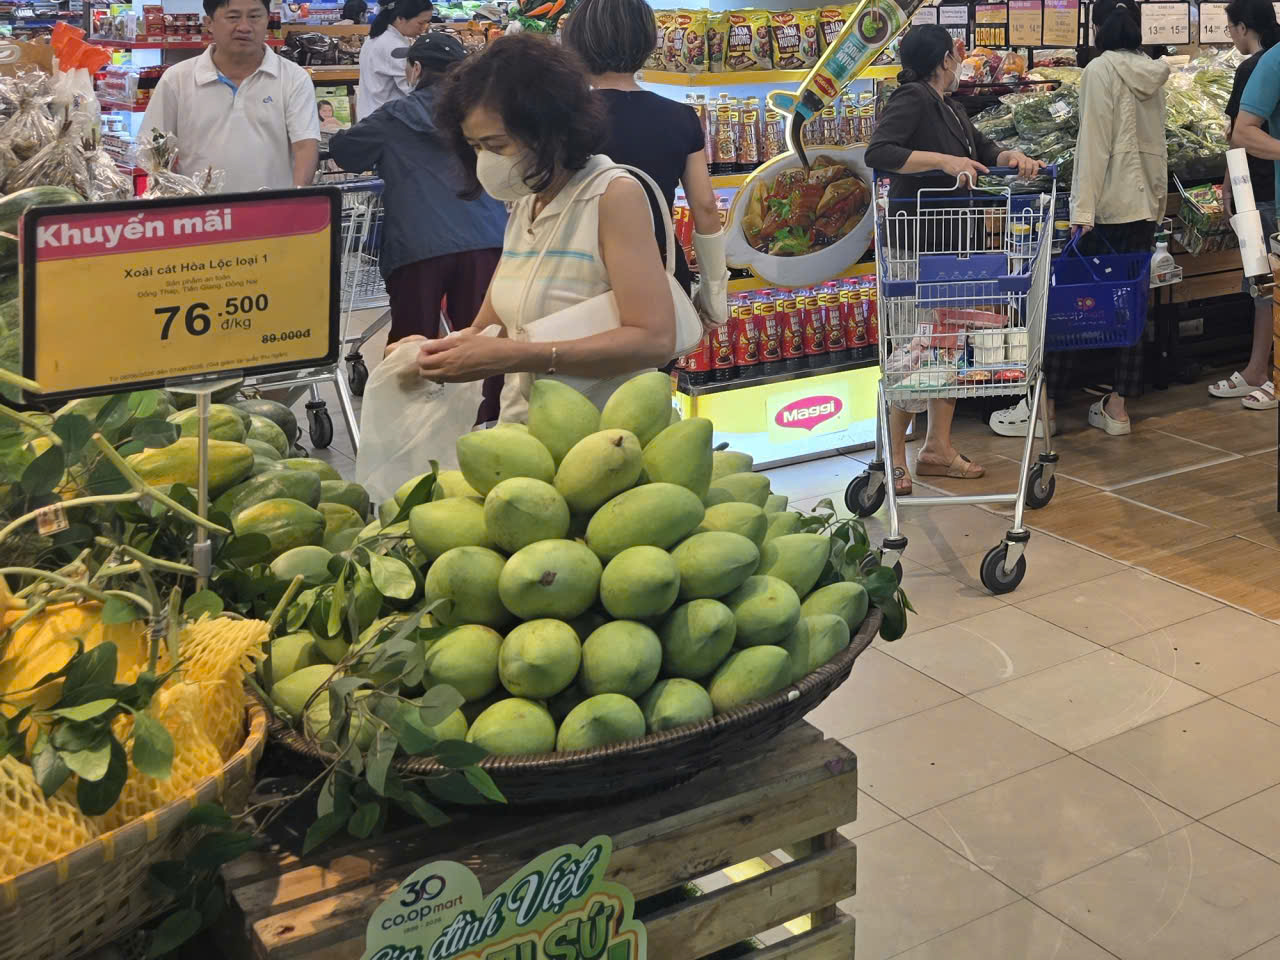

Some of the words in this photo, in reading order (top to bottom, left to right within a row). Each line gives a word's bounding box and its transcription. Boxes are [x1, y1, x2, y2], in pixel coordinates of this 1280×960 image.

[36, 213, 165, 250] Khuyến
[173, 208, 232, 235] mãi
[124, 267, 153, 278] Xoài
[157, 263, 177, 275] cát
[181, 261, 206, 273] Hòa
[209, 258, 235, 270] Lộc
[236, 255, 258, 267] loại
[262, 254, 268, 264] 1
[154, 302, 211, 341] 76
[217, 293, 269, 317] .500
[220, 317, 251, 331] đ/kg
[784, 399, 835, 423] Maggi
[400, 874, 447, 907] 30
[507, 844, 603, 927] Việt
